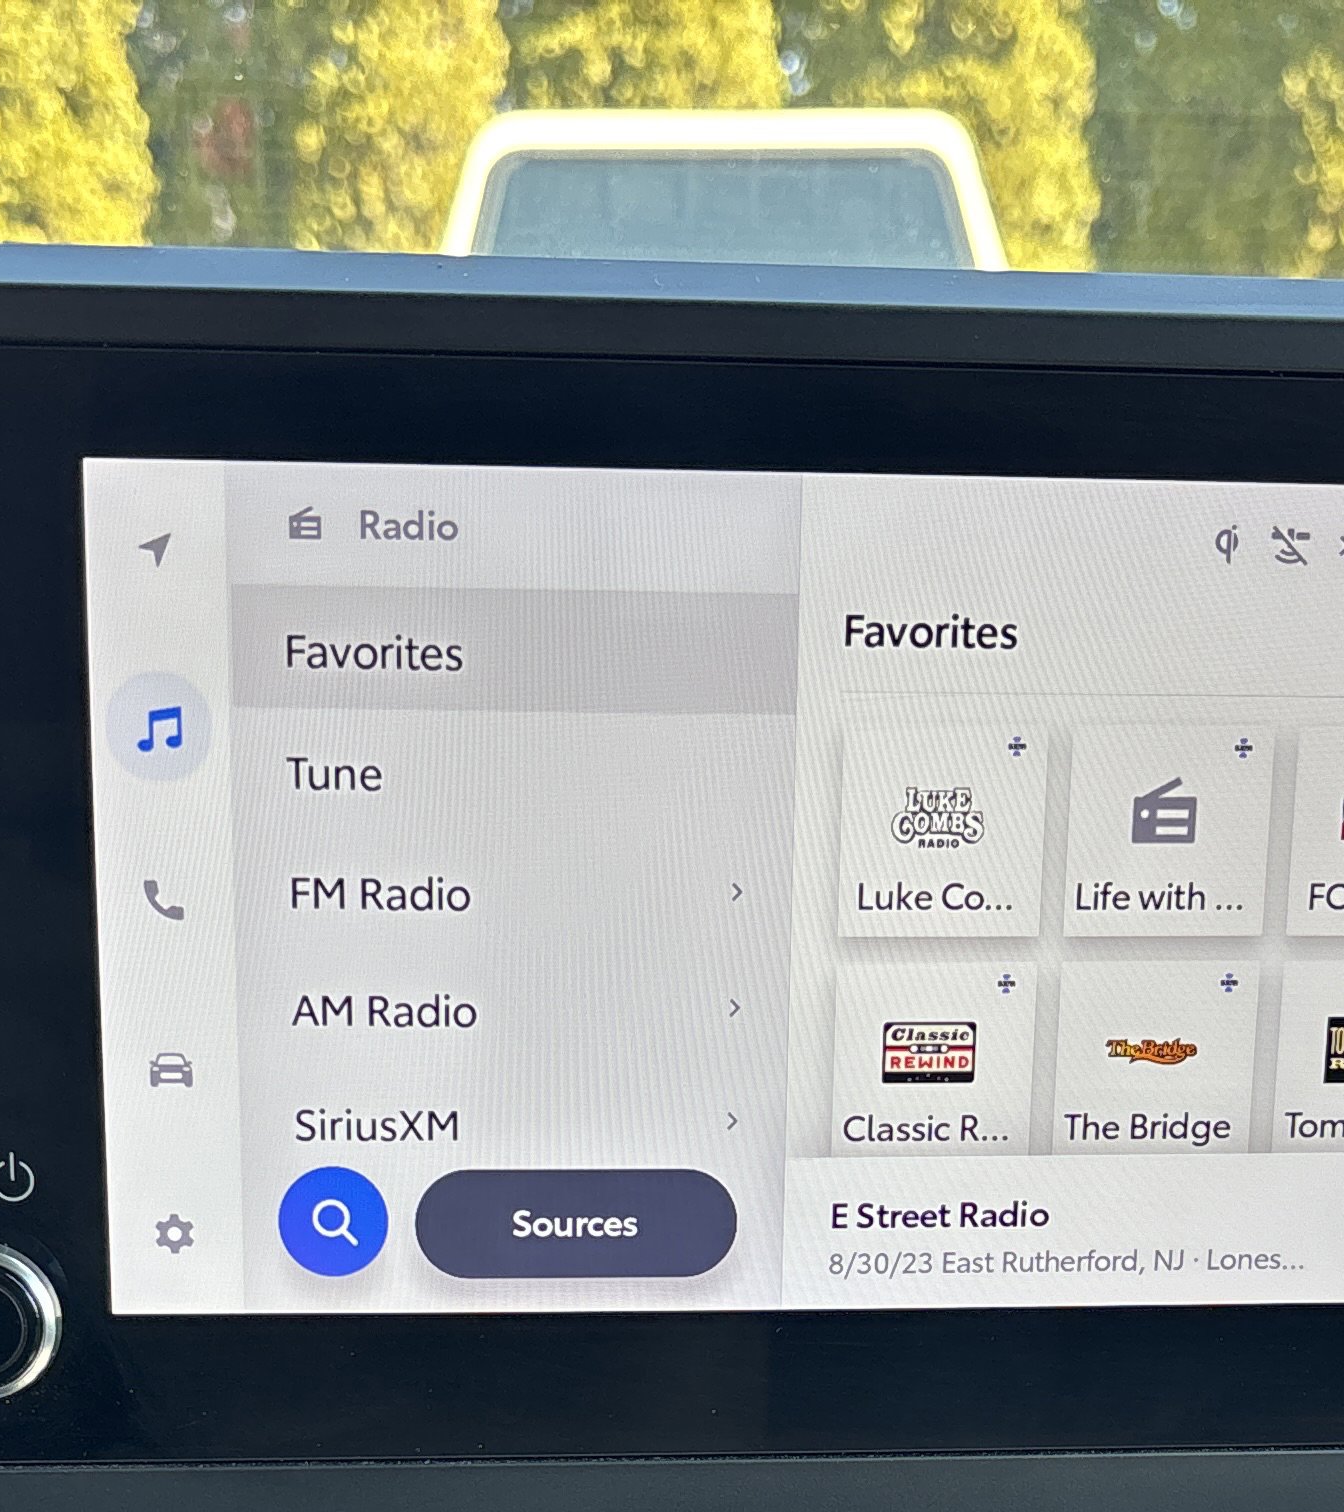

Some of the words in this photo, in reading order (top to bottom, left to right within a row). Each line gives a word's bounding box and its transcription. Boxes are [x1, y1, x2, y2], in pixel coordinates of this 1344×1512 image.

[358, 509, 459, 541] Radio
[844, 614, 1019, 650] Favorites
[286, 634, 464, 673] Favorites
[286, 757, 384, 793] Tune
[906, 787, 972, 813] LUKE
[891, 811, 985, 844] COMBS
[917, 838, 960, 849] RADIO
[290, 876, 346, 910] FM
[360, 876, 471, 912] Radio
[857, 881, 933, 911] Luke
[941, 882, 1013, 911] Co...
[1075, 881, 1131, 911] Life
[1137, 881, 1206, 911] with
[291, 995, 354, 1027] AM
[367, 994, 478, 1029] Radio
[891, 1028, 970, 1041] Classic
[890, 1056, 969, 1069] REWIND
[294, 1108, 460, 1143] SiriusXM
[843, 1114, 951, 1142] Classic
[960, 1114, 1009, 1142] R...
[1064, 1112, 1120, 1141] The
[1130, 1111, 1232, 1147] Bridge
[511, 1209, 639, 1239] Sources
[831, 1203, 849, 1229] E
[856, 1203, 951, 1229] Street
[959, 1201, 1050, 1229] Radio
[828, 1251, 934, 1280] 8/30/23
[942, 1251, 995, 1274] East
[1002, 1249, 1146, 1275] Rutherford,
[1154, 1250, 1185, 1271] NJ
[1206, 1249, 1306, 1271] Lones...
